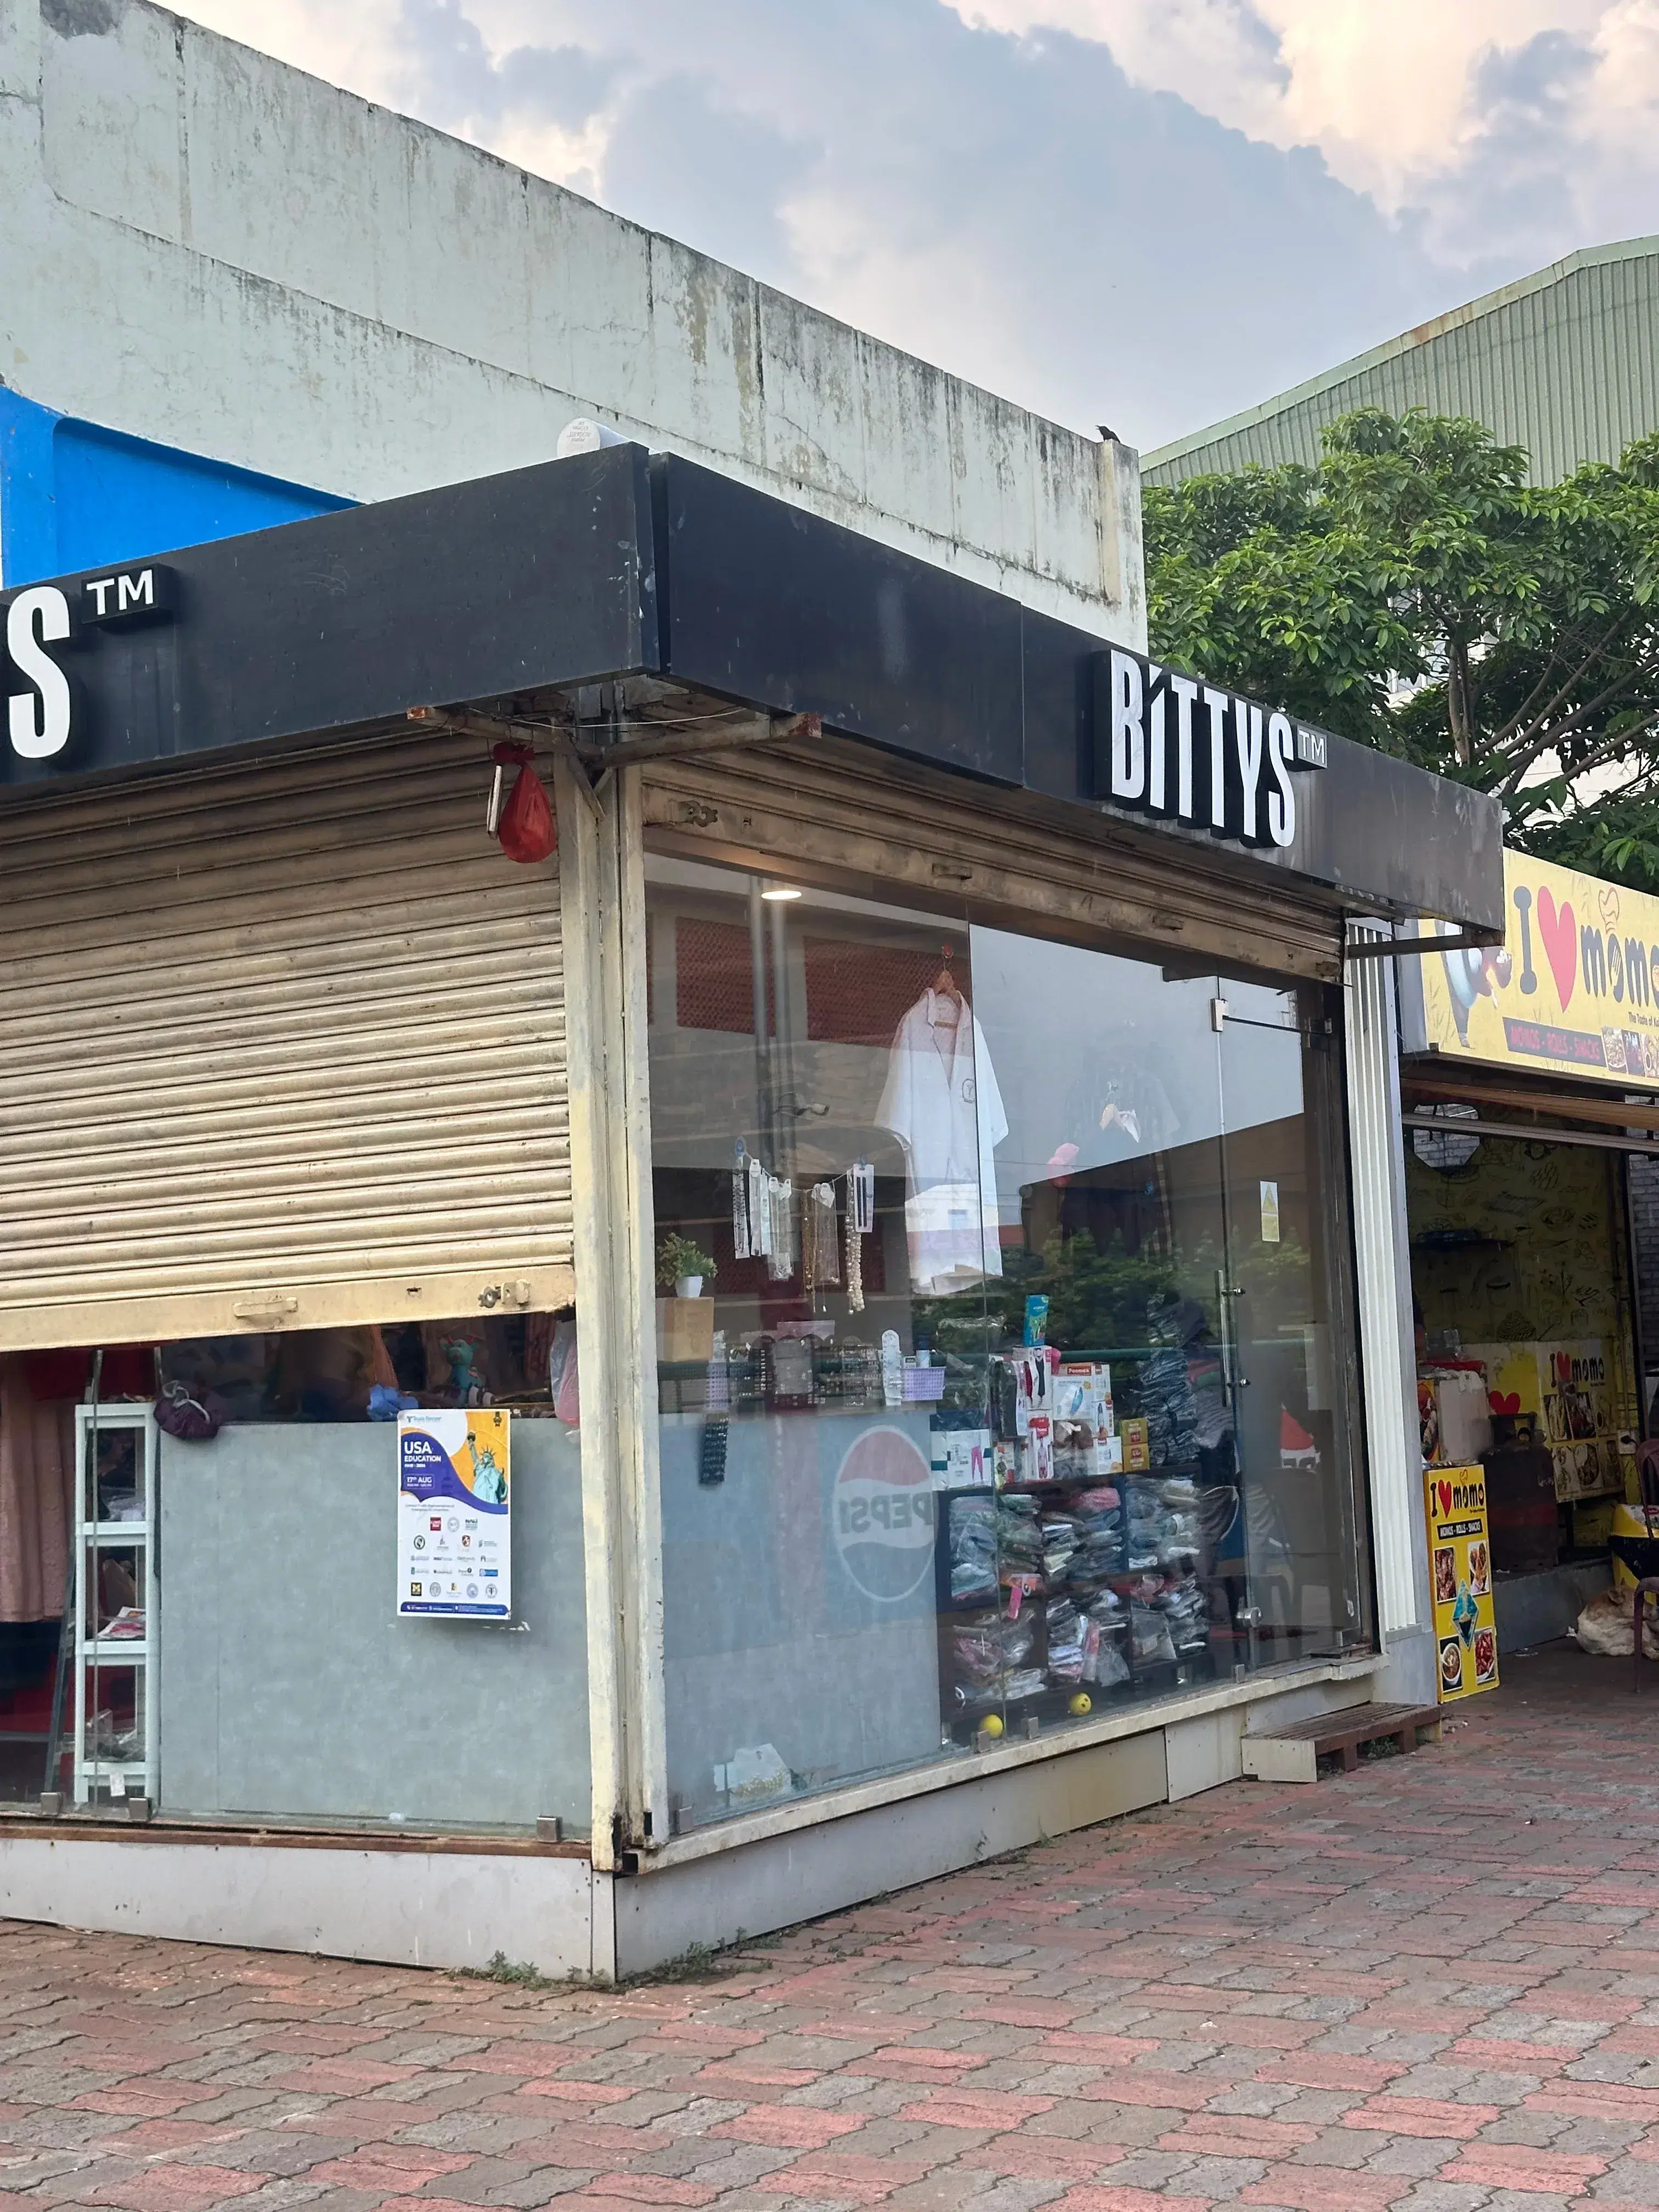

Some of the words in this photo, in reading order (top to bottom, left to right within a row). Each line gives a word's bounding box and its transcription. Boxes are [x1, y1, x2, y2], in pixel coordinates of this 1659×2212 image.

[1514, 885, 1537, 995] I
[1572, 1357, 1605, 1383] momo
[404, 1441, 432, 1454] USA
[1430, 1482, 1438, 1518] I
[1453, 1482, 1485, 1510] momo
